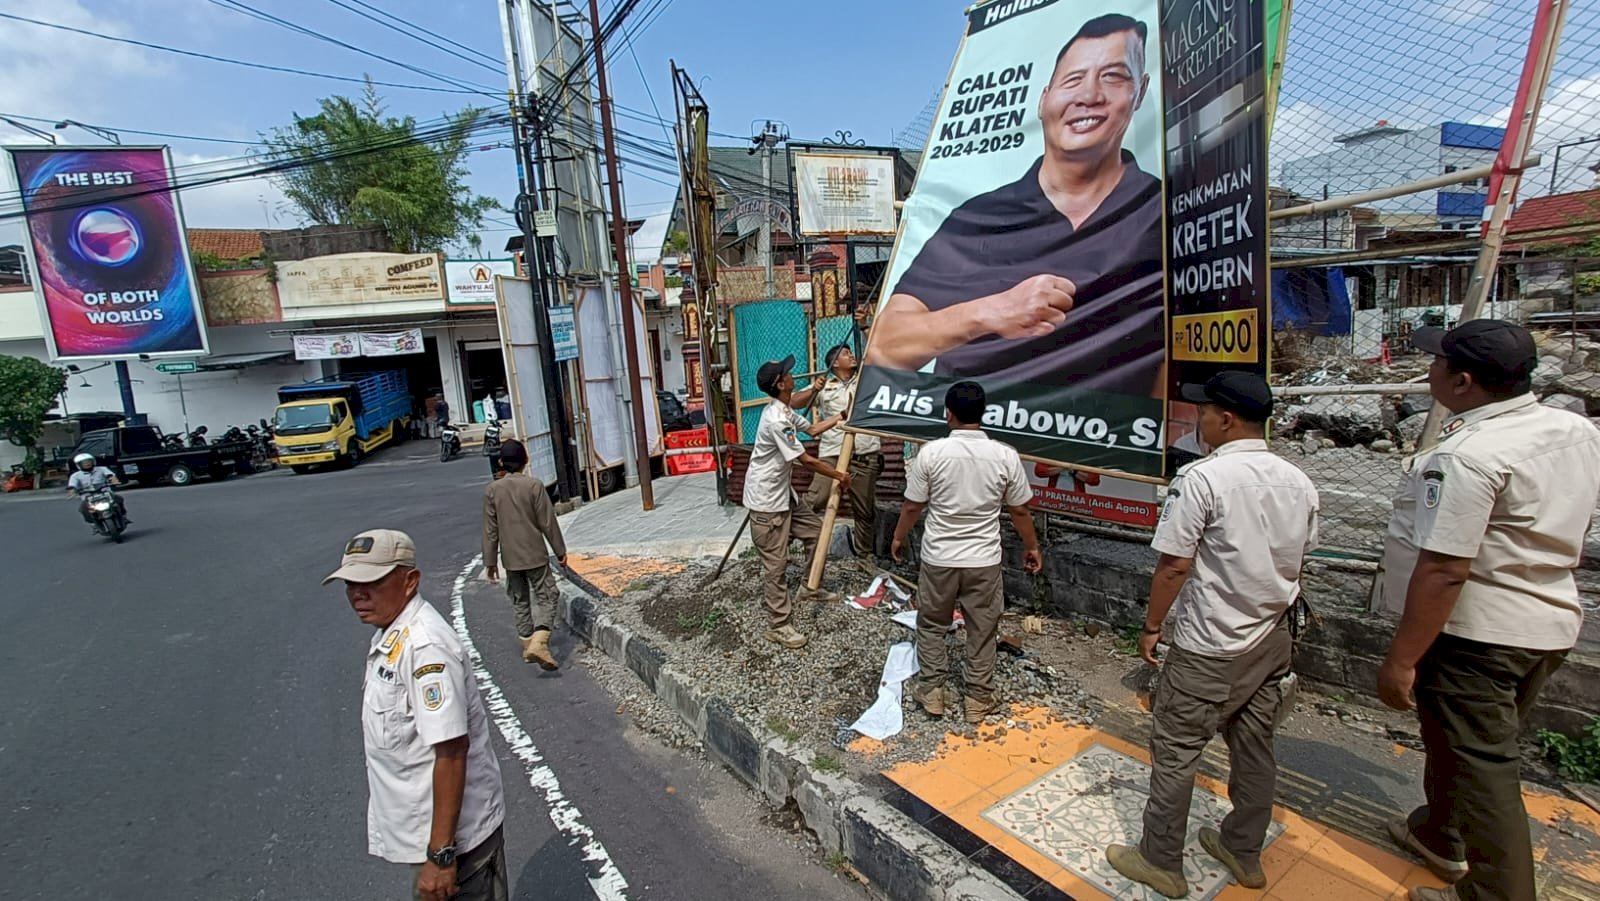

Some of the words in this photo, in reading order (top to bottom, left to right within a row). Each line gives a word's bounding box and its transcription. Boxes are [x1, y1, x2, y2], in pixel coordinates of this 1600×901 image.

[1164, 0, 1236, 71] MAGN
[1177, 14, 1237, 89] KRETEK
[957, 62, 1033, 95] CALON
[949, 85, 1029, 118] BUPATI
[939, 108, 1026, 141] KLATEN
[930, 132, 1025, 160] 2024-2029
[55, 172, 89, 186] THE
[92, 171, 133, 186] BEST
[1172, 163, 1252, 217] KENIKMATAN
[1172, 199, 1254, 259] KRETEK
[387, 256, 433, 276] COMFEED
[1172, 252, 1253, 297] MODERN
[83, 291, 107, 306] OF
[111, 289, 159, 304] BOTH
[86, 308, 164, 325] WORLDS
[868, 384, 934, 416] Aris
[943, 399, 1118, 448] abowo,
[1045, 490, 1086, 505] PRATAMA
[1088, 498, 1113, 510] (Andi
